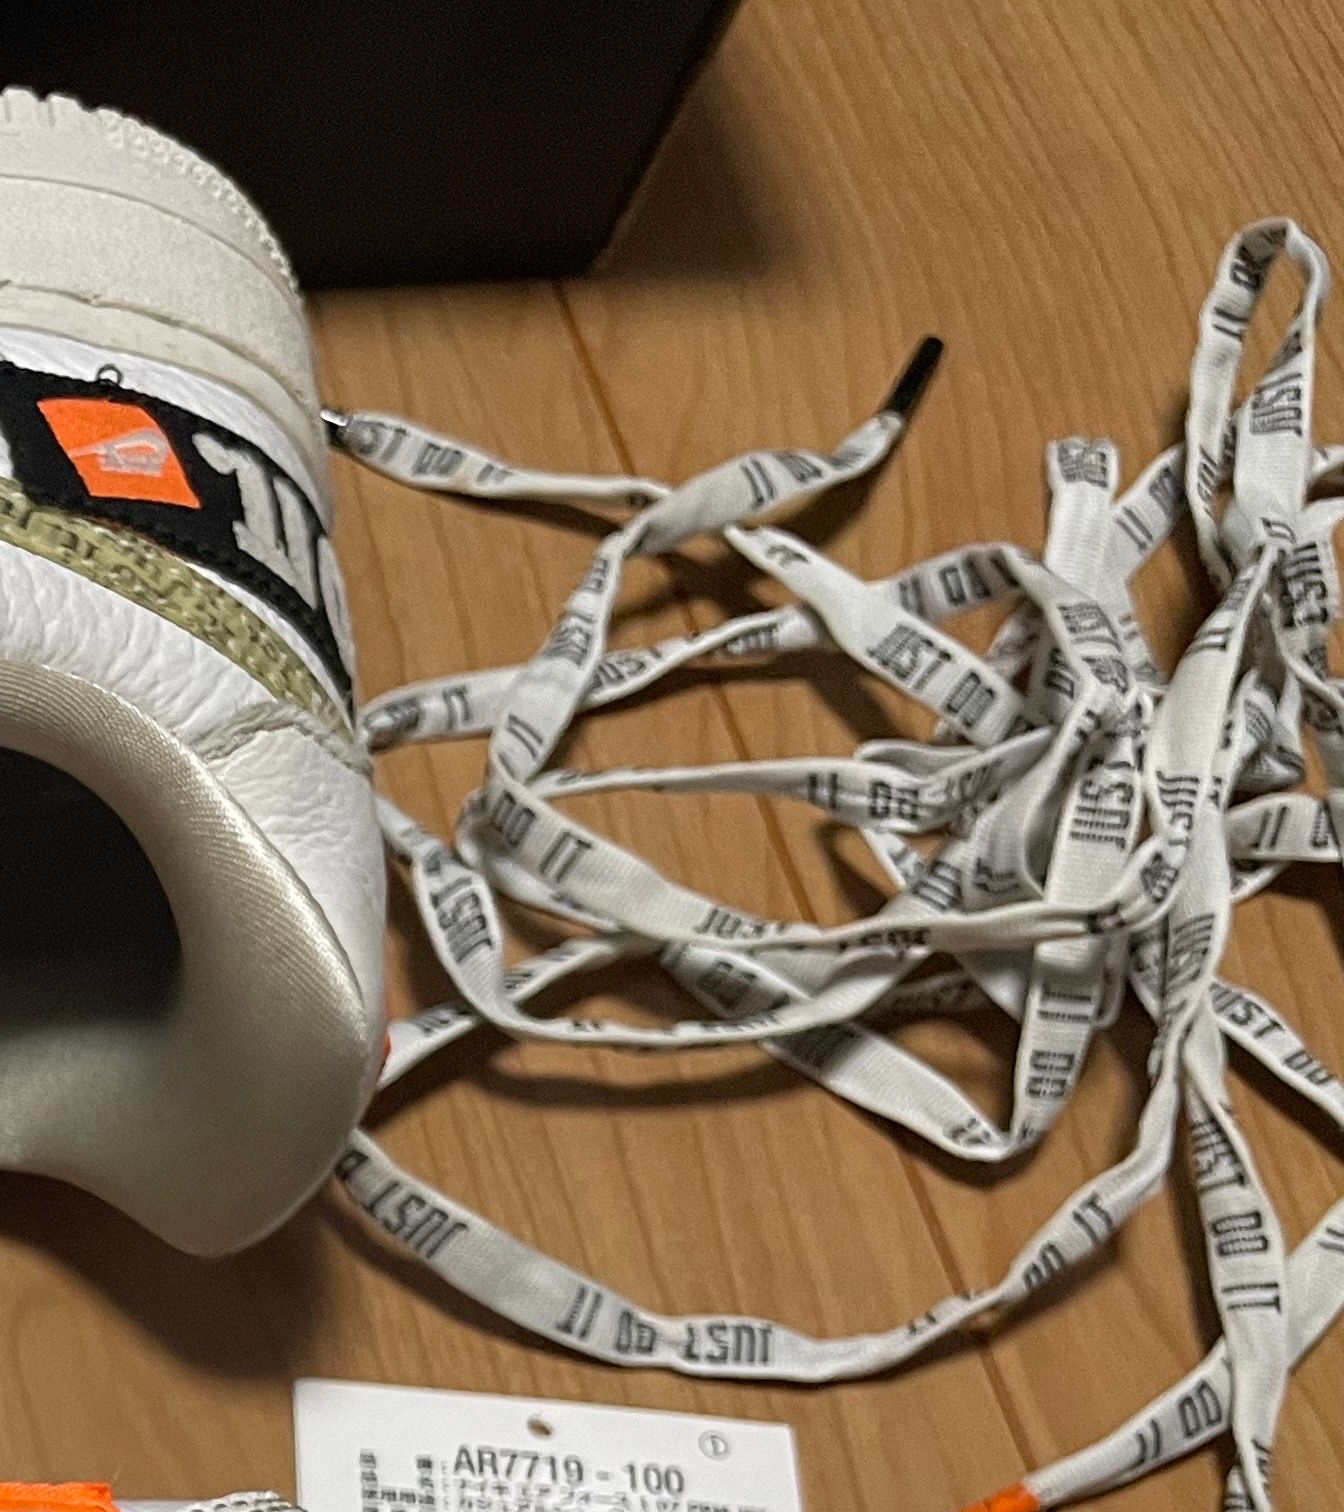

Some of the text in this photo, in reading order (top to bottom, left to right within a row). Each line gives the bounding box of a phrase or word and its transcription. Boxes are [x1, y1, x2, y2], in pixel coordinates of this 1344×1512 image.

[365, 1180, 470, 1260] JUST
[1212, 1210, 1283, 1315] DO IT
[683, 1319, 773, 1364] JUST
[452, 1444, 585, 1487] AR7719
[623, 1461, 686, 1497] 100
